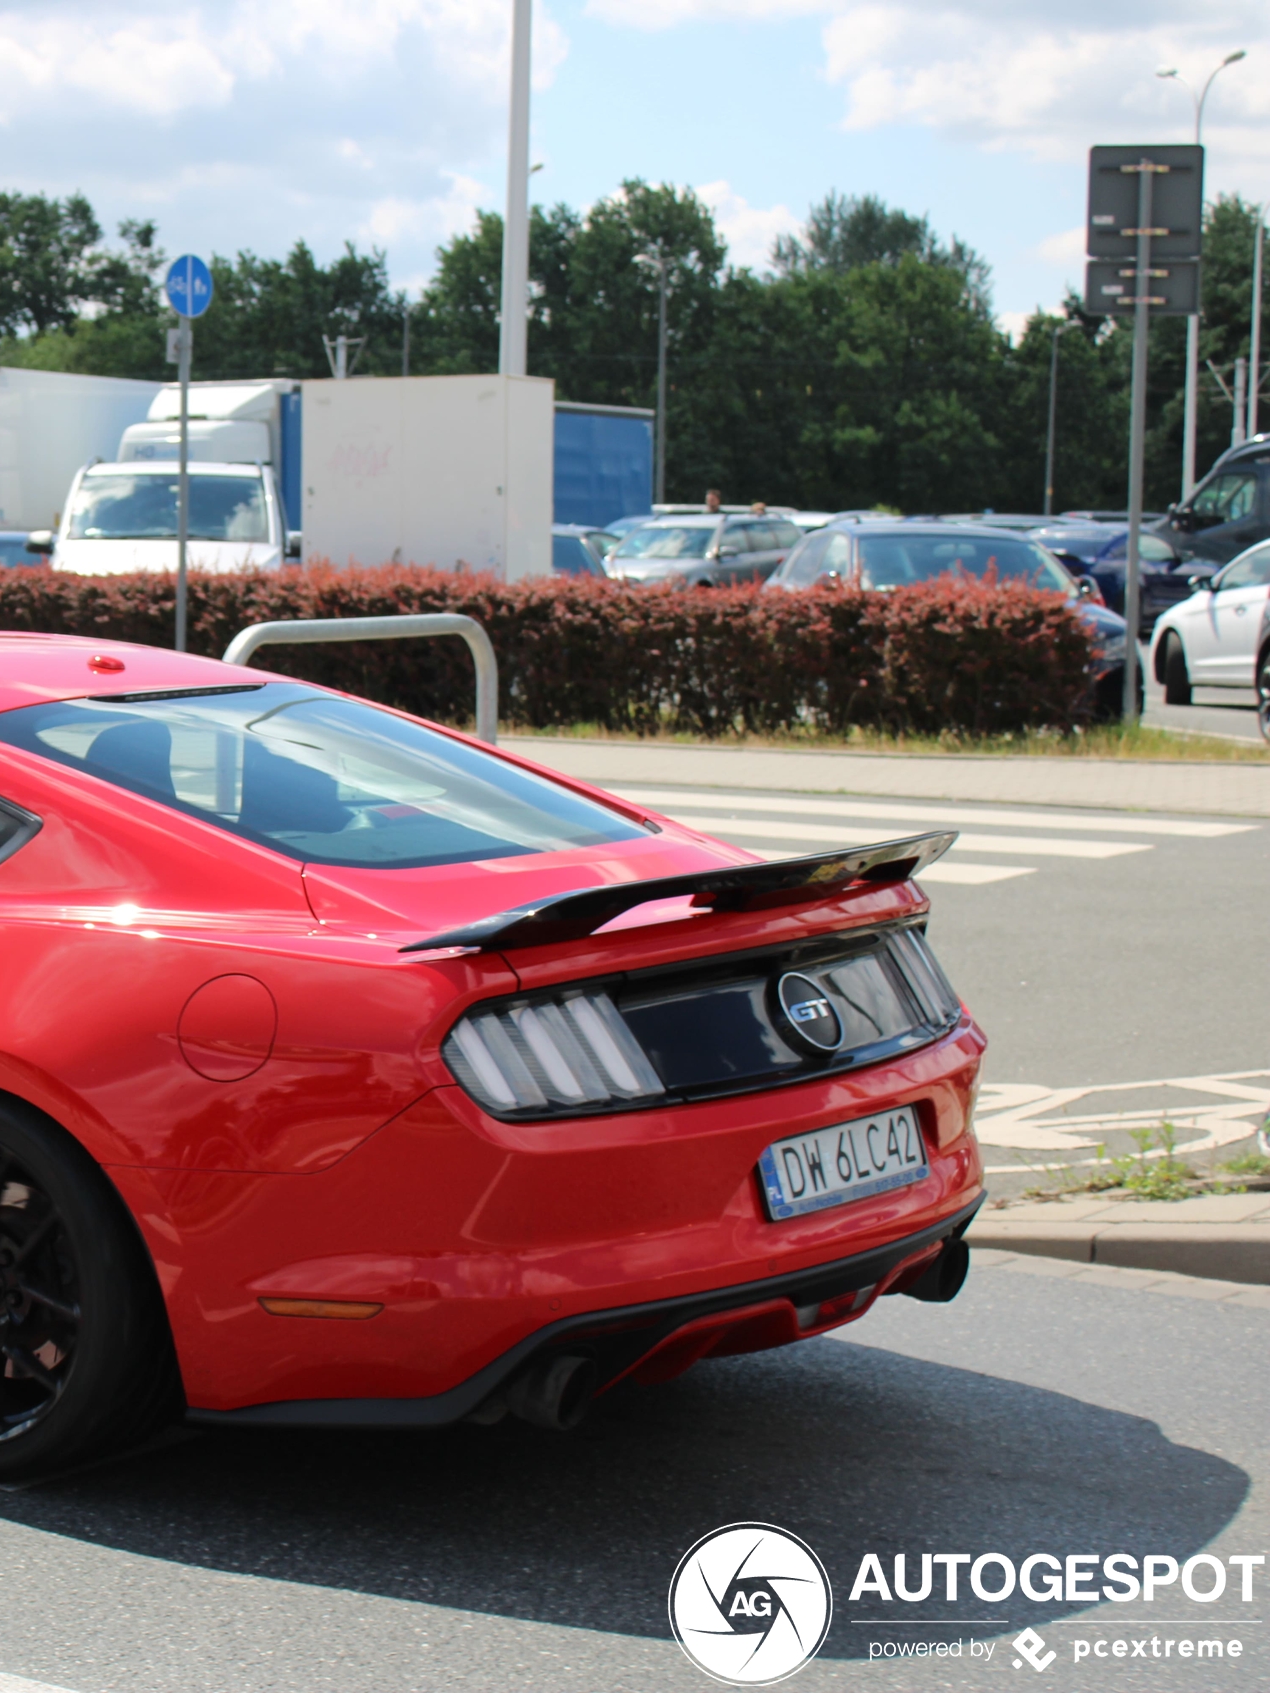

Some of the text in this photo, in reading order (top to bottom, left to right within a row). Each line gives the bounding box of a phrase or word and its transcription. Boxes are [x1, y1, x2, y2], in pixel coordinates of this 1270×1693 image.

[790, 998, 829, 1023] GT
[781, 1115, 916, 1198] DW 6LC42
